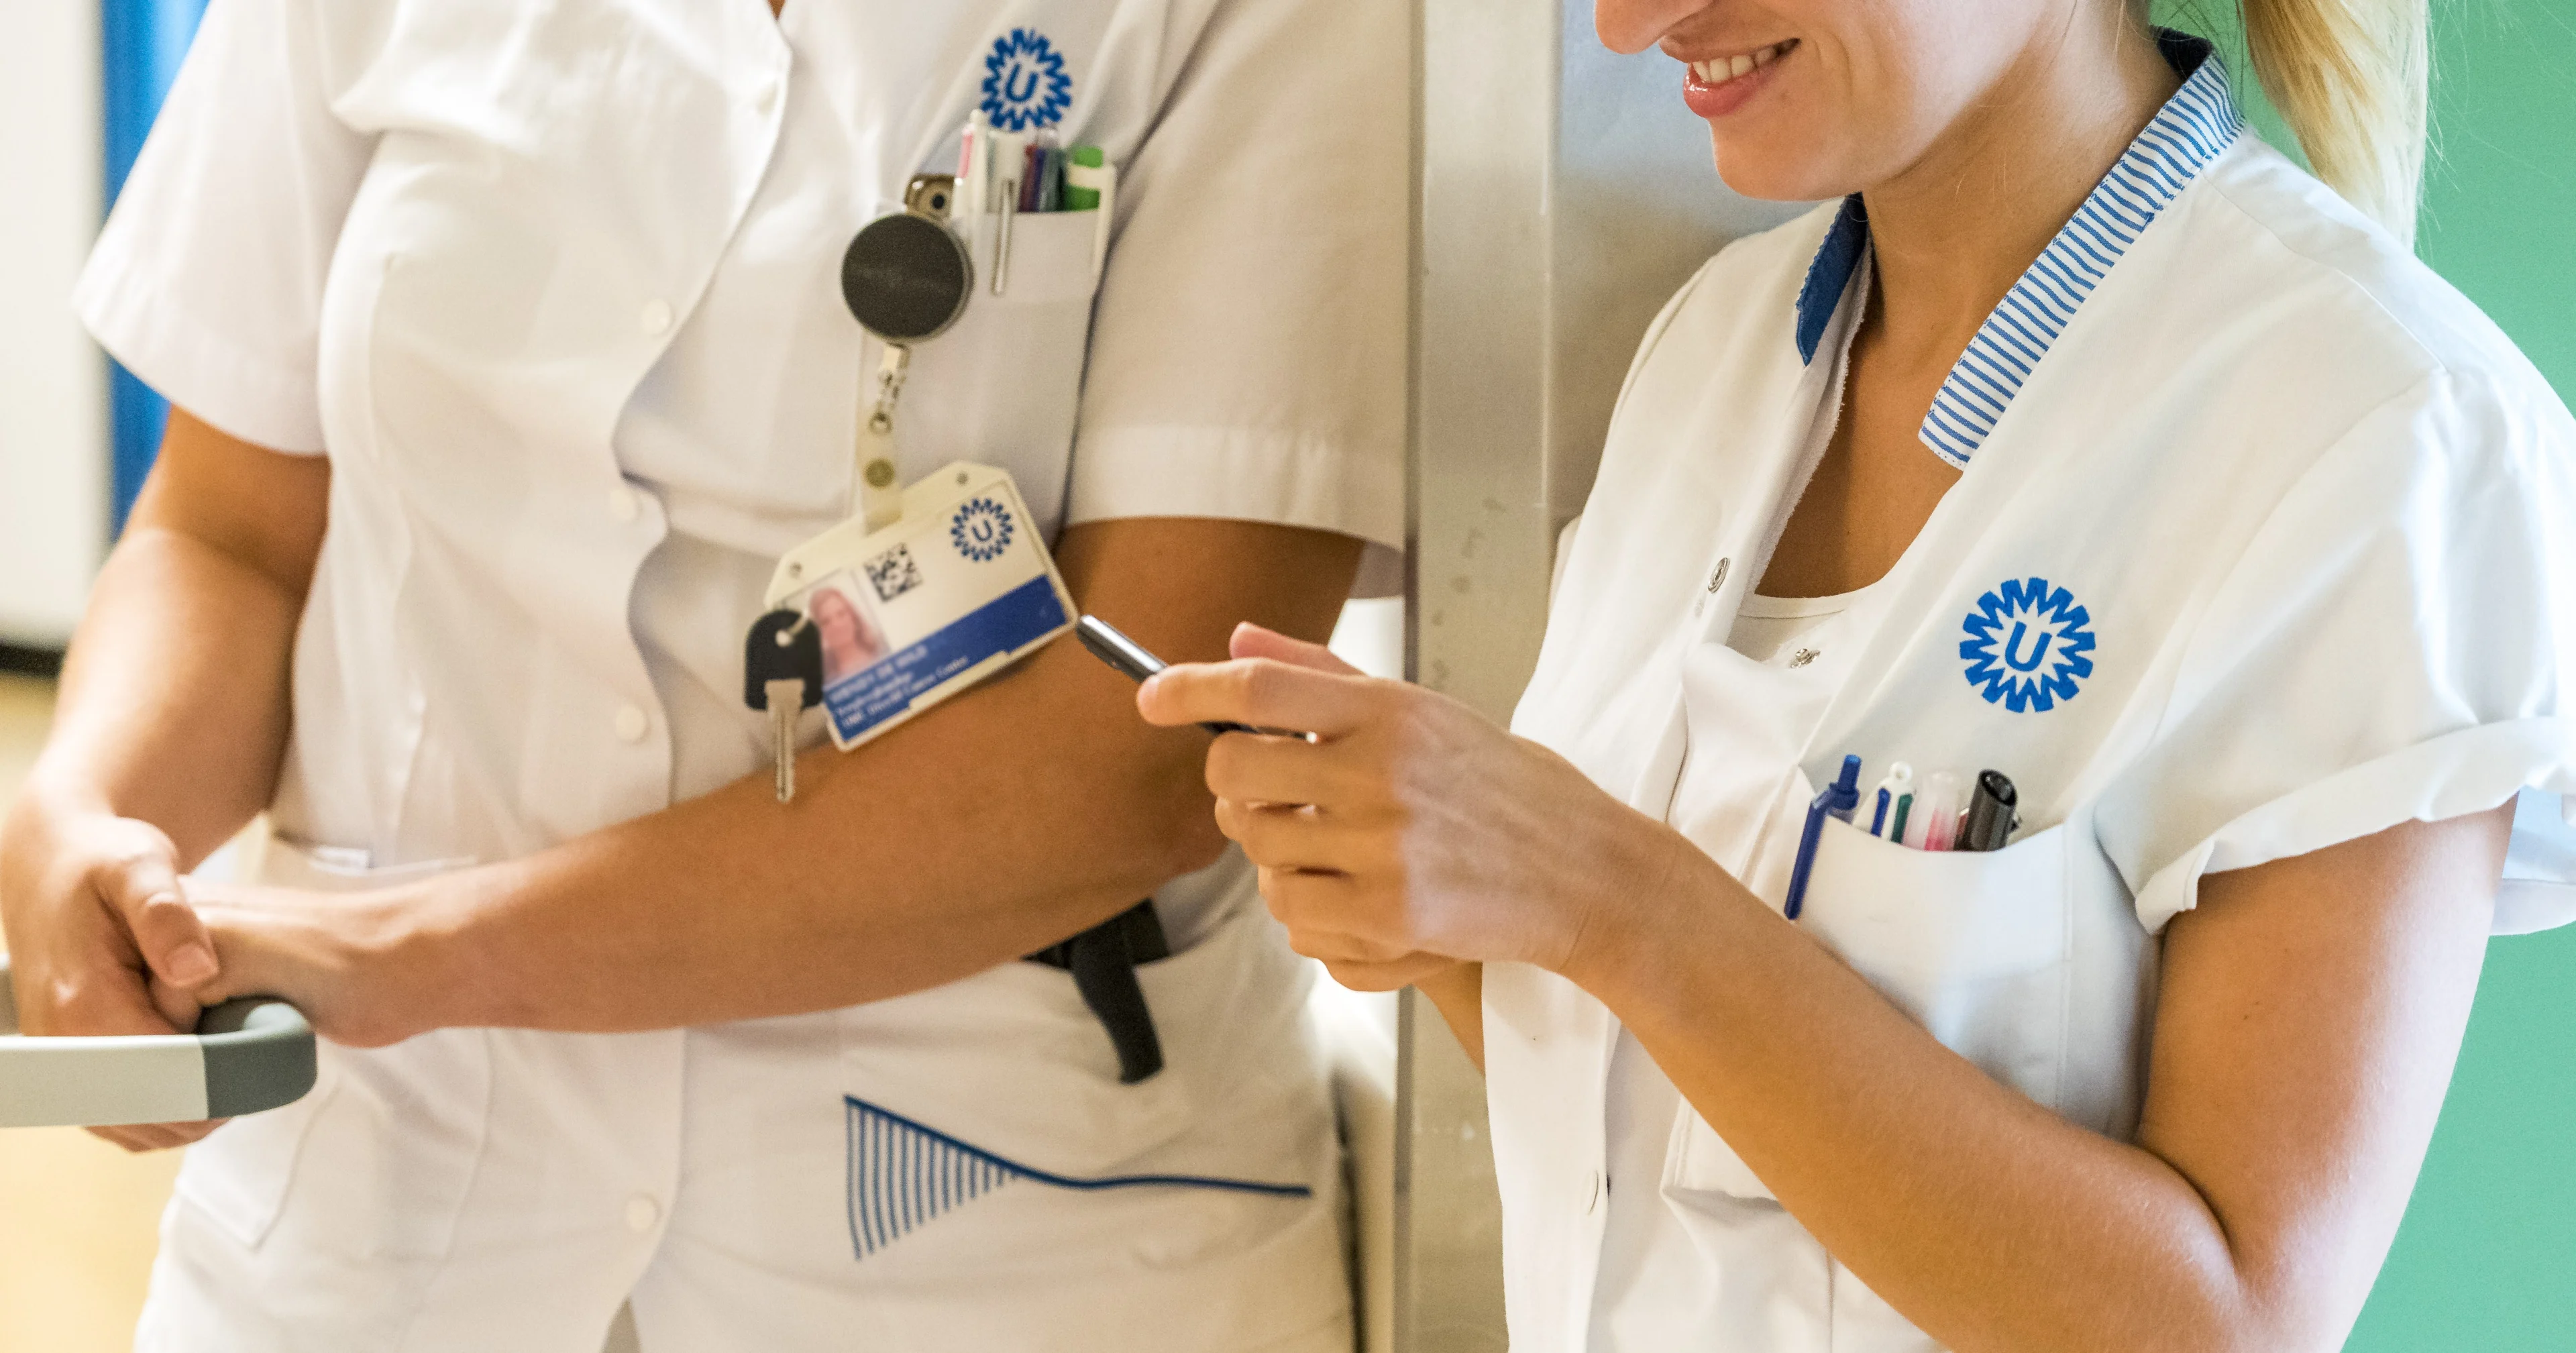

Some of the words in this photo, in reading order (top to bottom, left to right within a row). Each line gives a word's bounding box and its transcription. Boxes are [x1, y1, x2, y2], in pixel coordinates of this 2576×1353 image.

[1006, 64, 1038, 103] U
[971, 520, 992, 541] U
[2004, 620, 2053, 672] U
